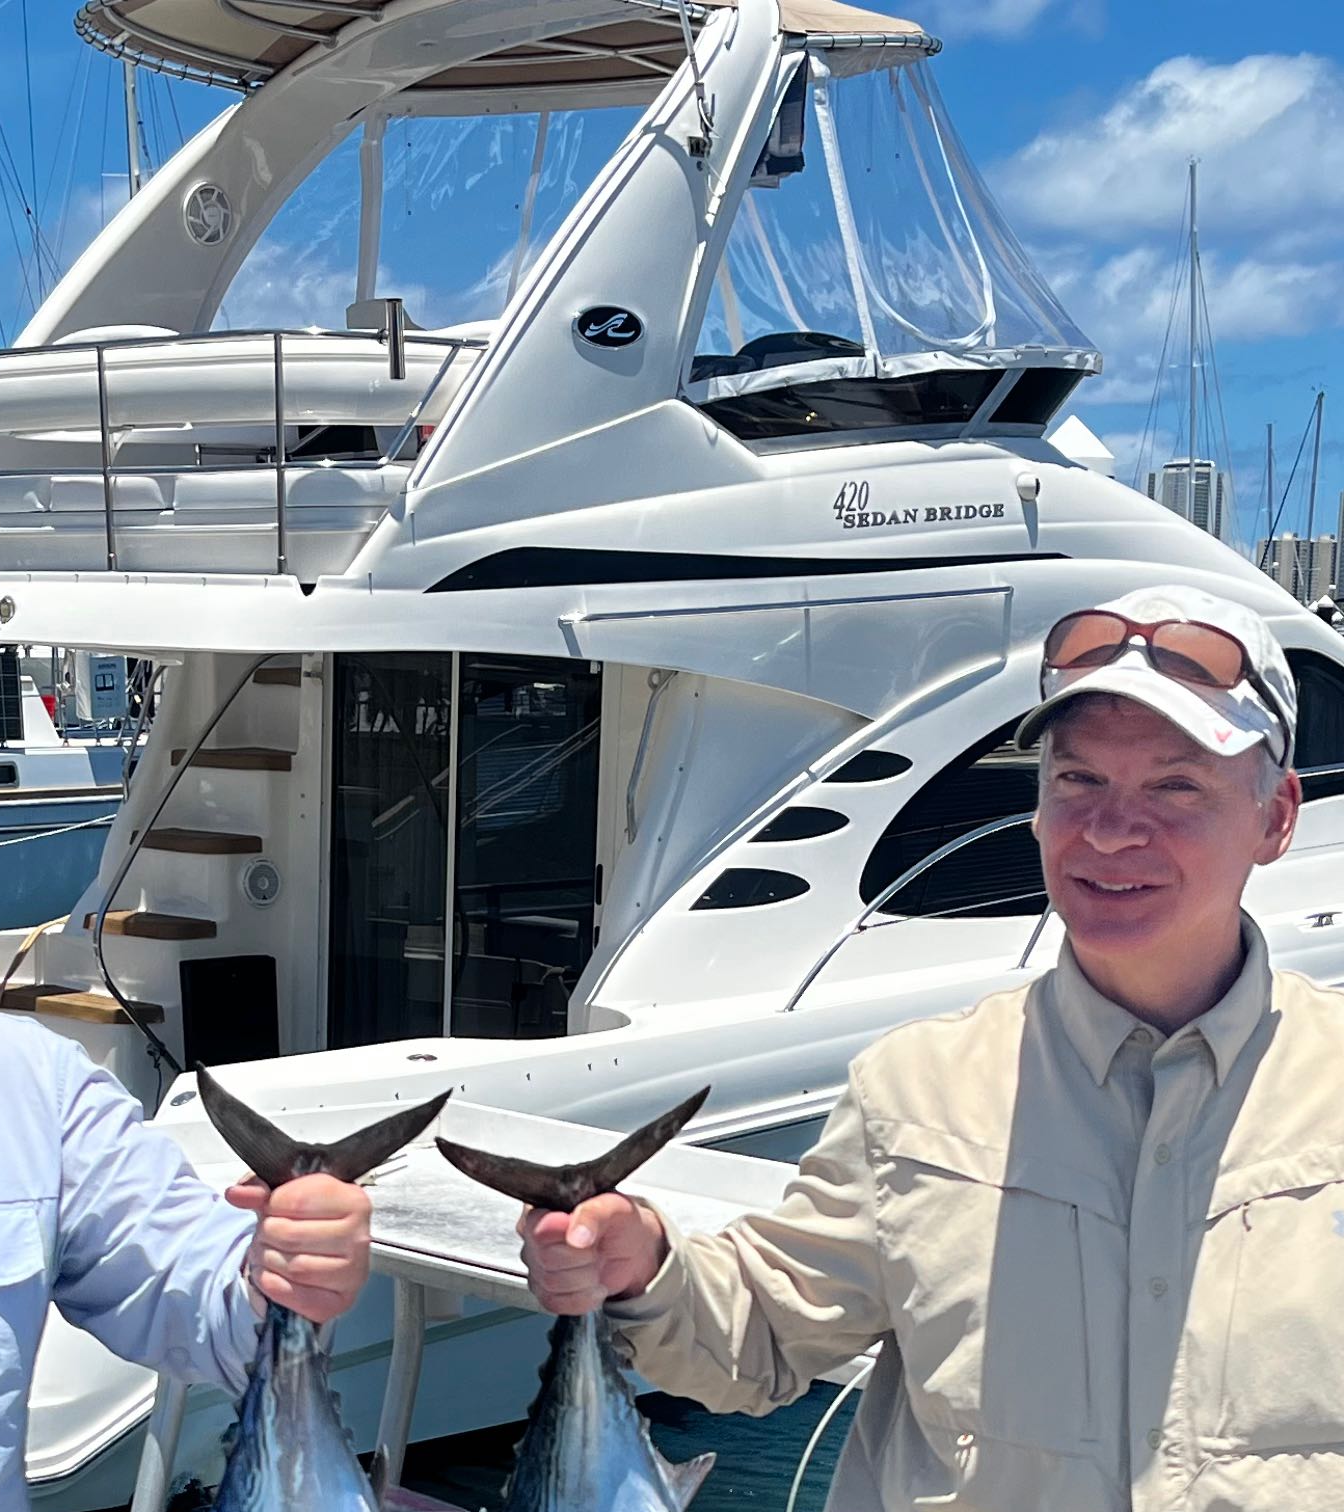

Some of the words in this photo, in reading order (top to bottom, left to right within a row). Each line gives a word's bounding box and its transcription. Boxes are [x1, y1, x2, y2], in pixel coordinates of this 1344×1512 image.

[833, 480, 870, 520] 420
[843, 508, 919, 529] SEDAN
[924, 503, 1004, 522] BRIDGE
